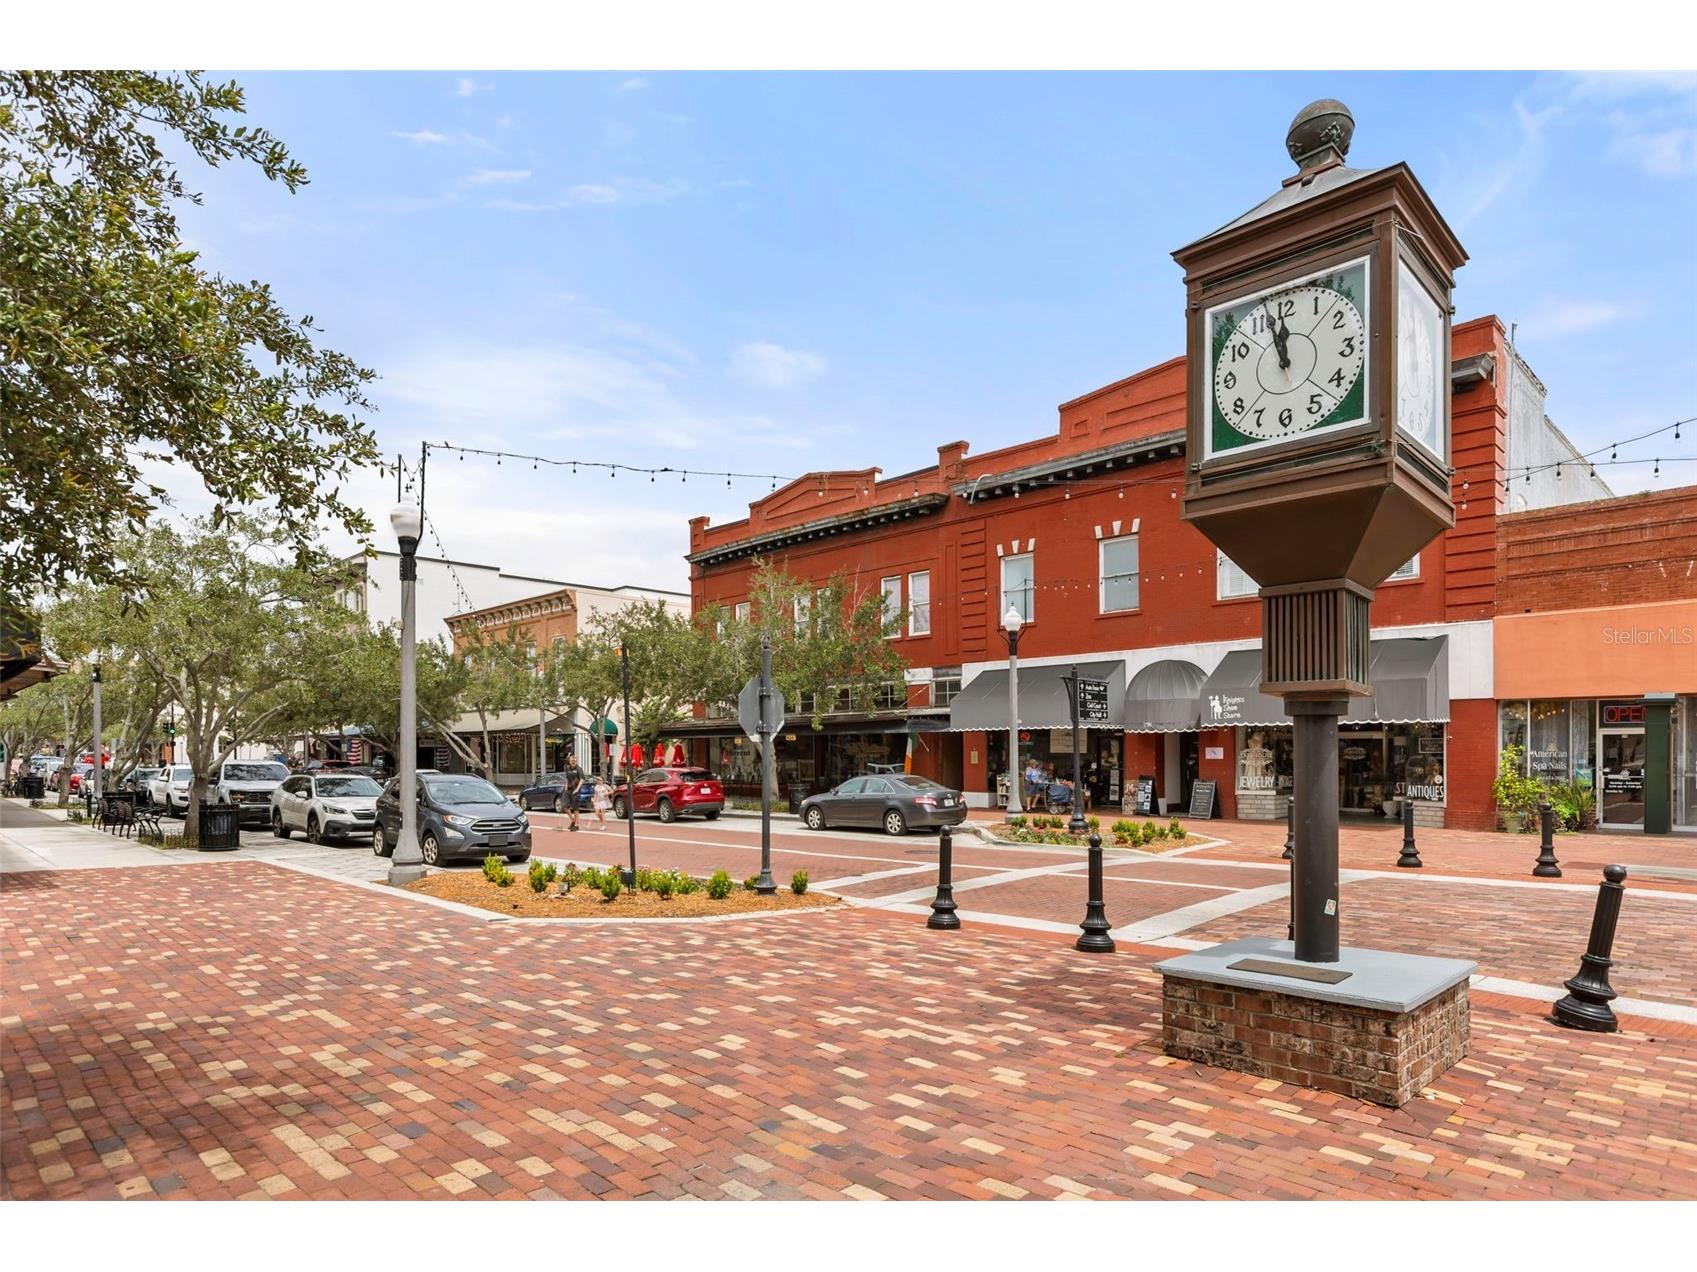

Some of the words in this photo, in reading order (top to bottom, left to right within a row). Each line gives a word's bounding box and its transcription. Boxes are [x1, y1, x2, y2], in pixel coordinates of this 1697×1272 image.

[1277, 300, 1296, 320] 12
[1312, 296, 1319, 315] 1
[1252, 314, 1265, 335] 11
[1333, 310, 1346, 329] 2
[1231, 342, 1250, 362] 10
[1338, 336, 1355, 357] 3
[1224, 371, 1236, 389] 9
[1328, 368, 1346, 388] 4
[1233, 397, 1245, 415] 8
[1306, 394, 1323, 414] 5
[1253, 407, 1266, 427] 7
[1278, 408, 1292, 428] 6
[1531, 750, 1567, 758] American
[1532, 762, 1547, 771] Spa
[1549, 762, 1567, 770] Nails
[1240, 776, 1275, 788] JEWELRY
[1407, 785, 1444, 798] ANTIQUES
